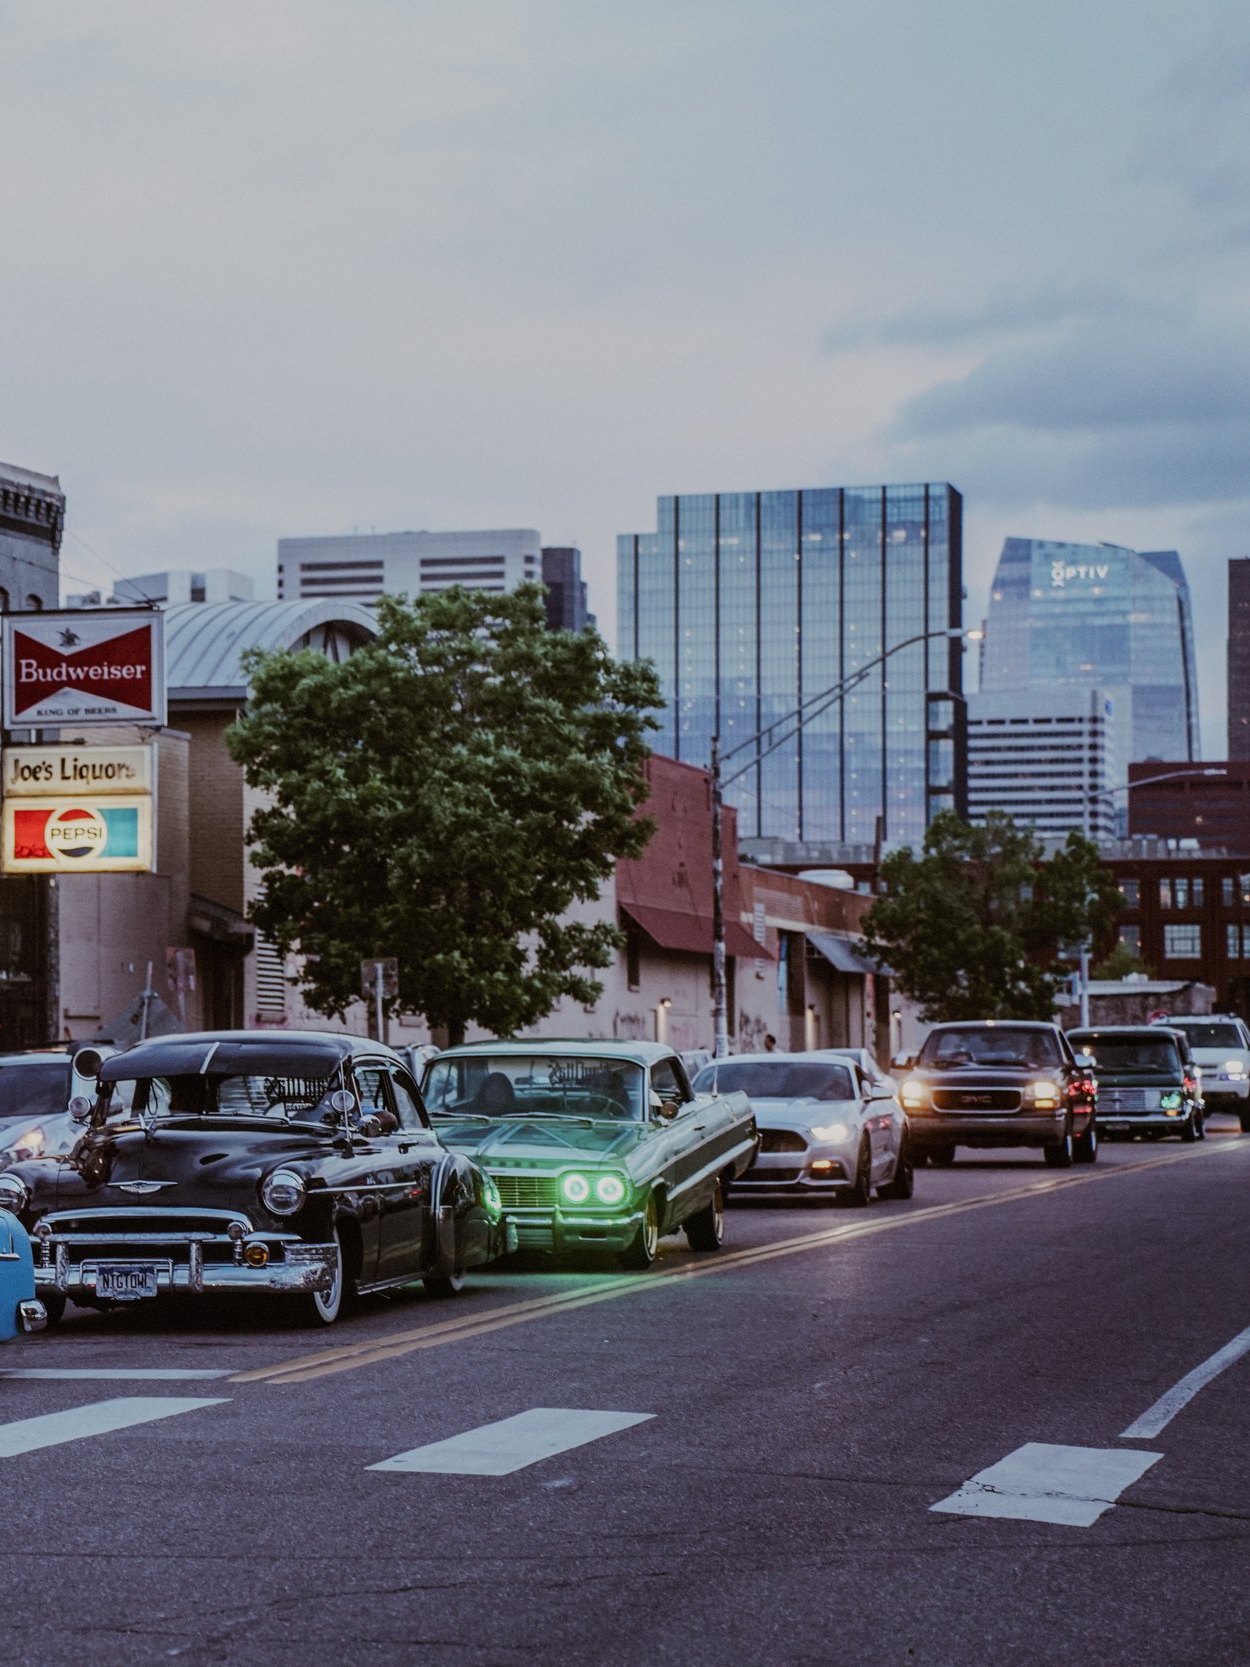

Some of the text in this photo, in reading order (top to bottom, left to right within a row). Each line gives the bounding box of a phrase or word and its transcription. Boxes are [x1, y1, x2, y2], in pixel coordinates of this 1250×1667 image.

[1051, 560, 1109, 588] OPTIV
[18, 658, 147, 683] Budweiser
[36, 706, 117, 717] KING OF BEERS
[10, 757, 137, 785] Joe's Liquors
[50, 827, 103, 840] PEPSI
